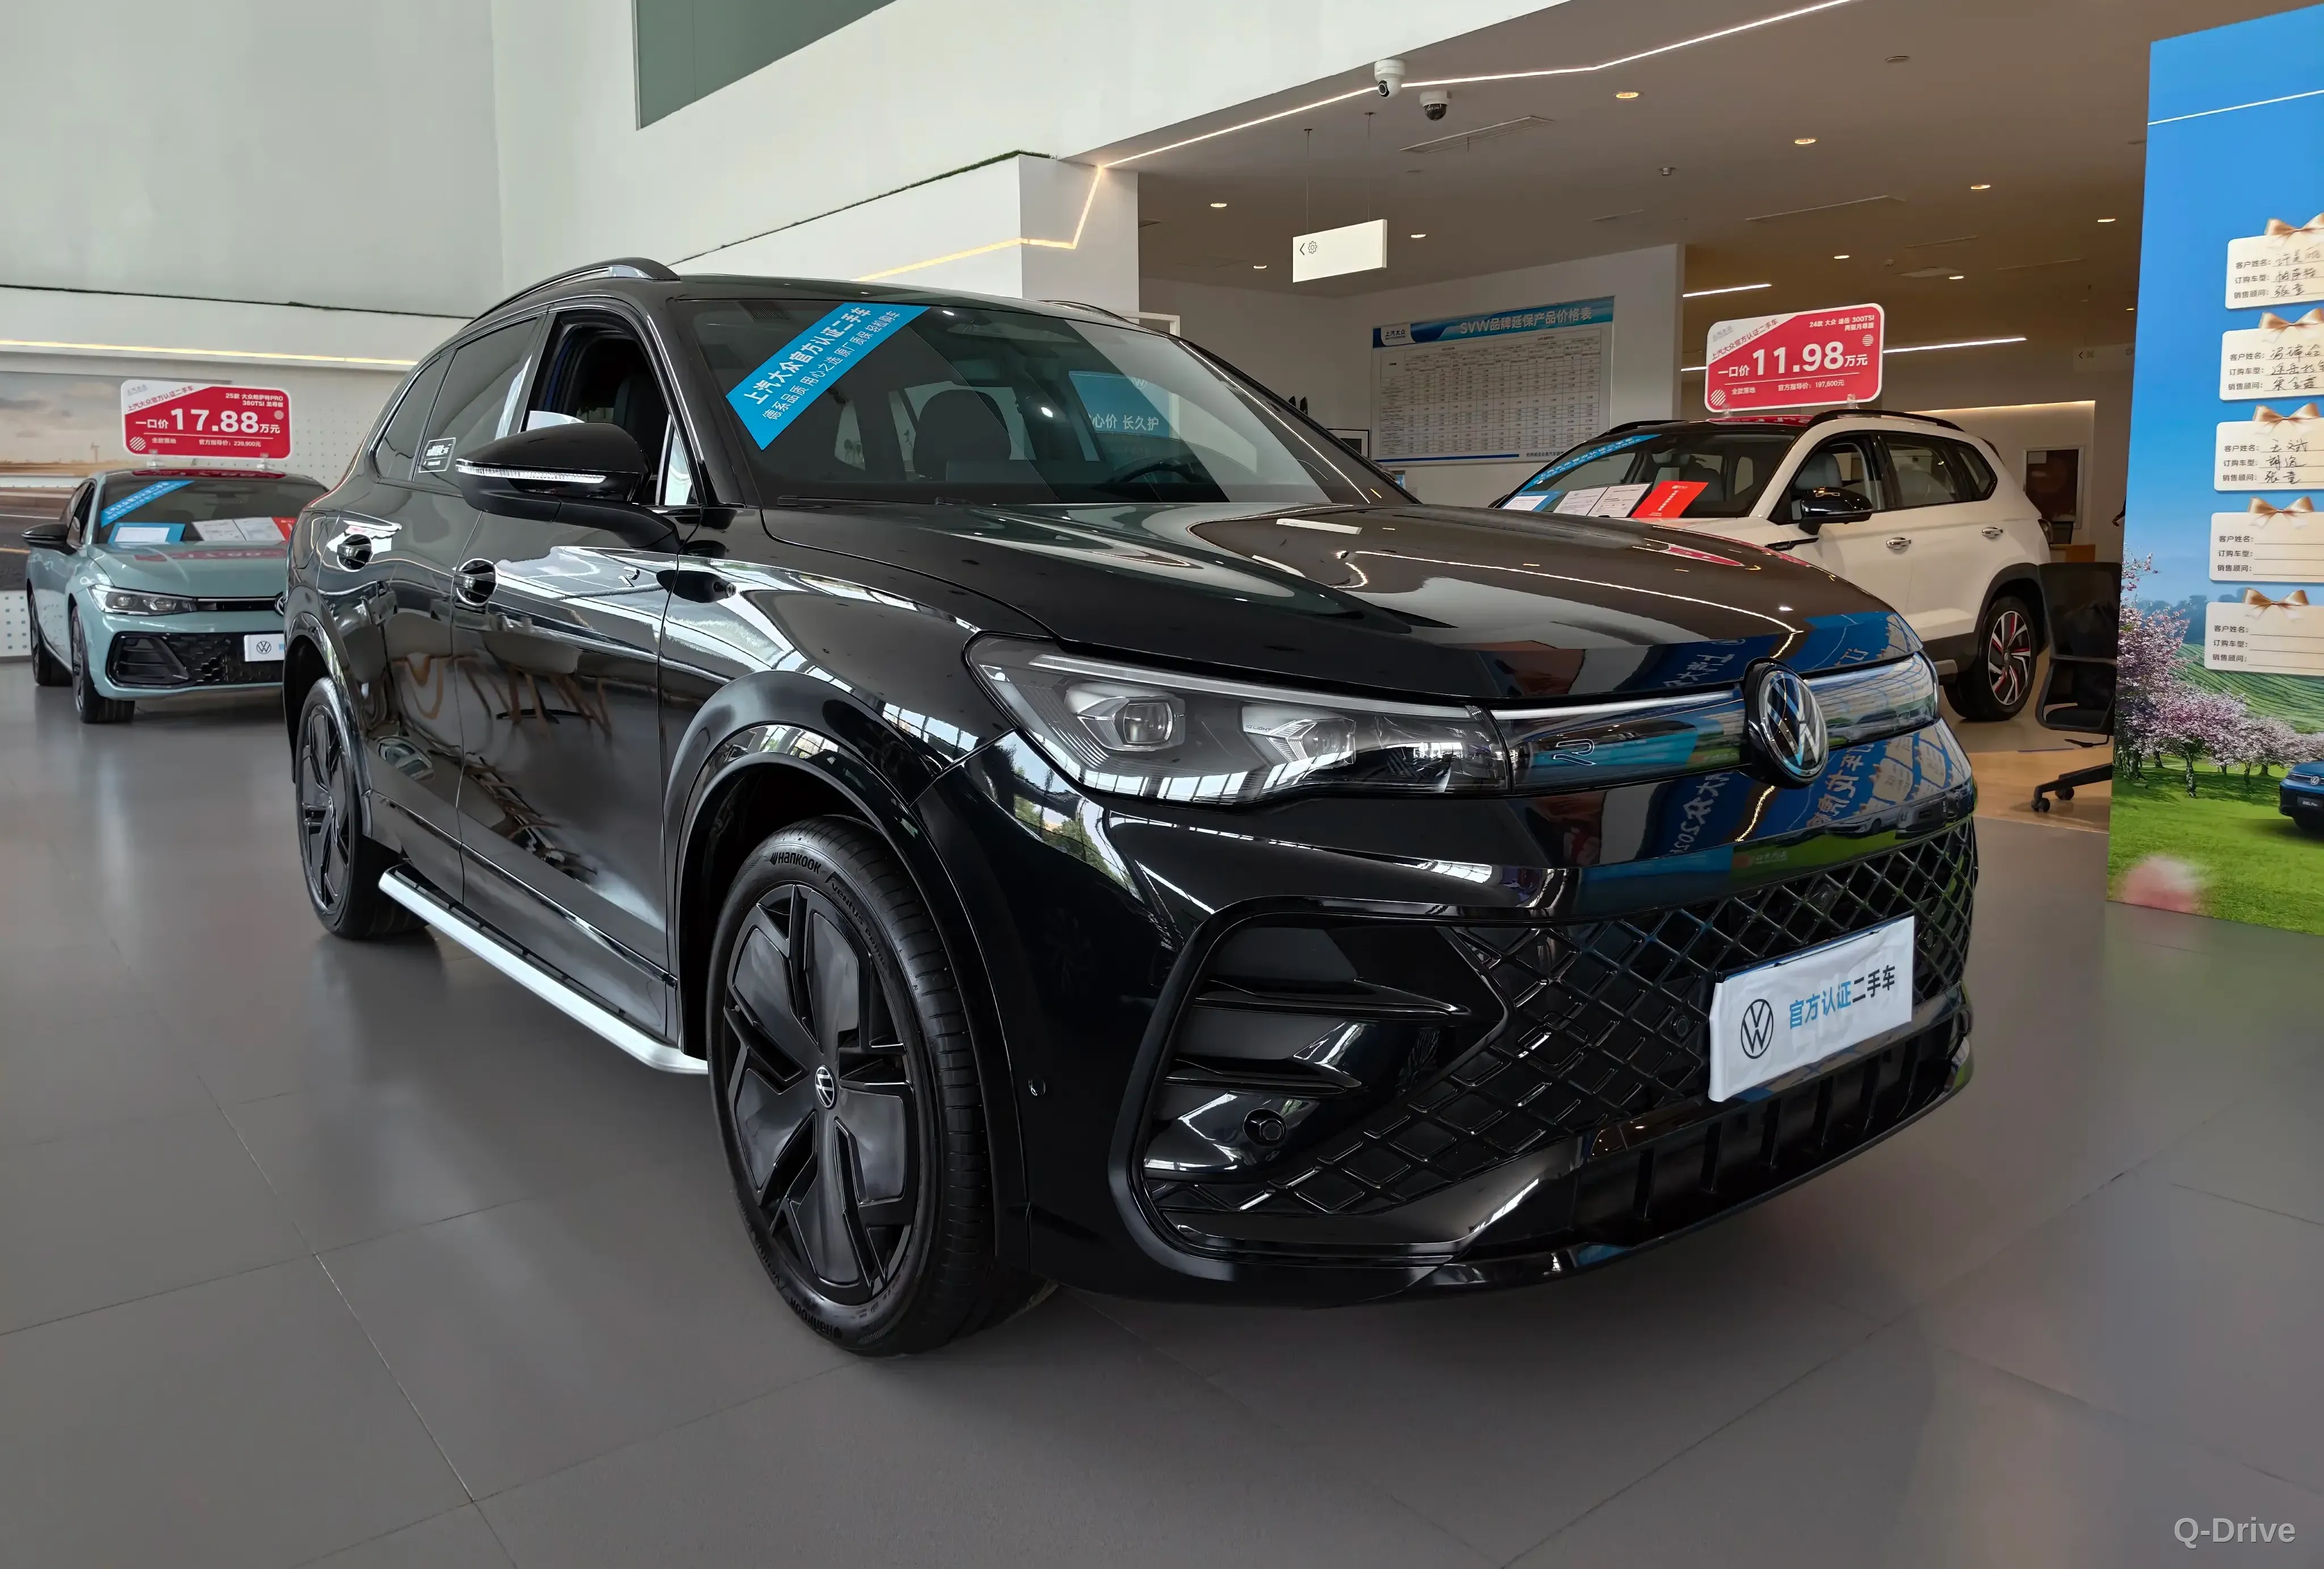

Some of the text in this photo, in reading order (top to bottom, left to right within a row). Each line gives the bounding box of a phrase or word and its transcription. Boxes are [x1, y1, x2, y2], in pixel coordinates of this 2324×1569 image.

[2235, 259, 2271, 269] 客户姓名：
[2234, 274, 2270, 284] 订购车型：
[2234, 289, 2269, 299] 销售顾问：
[1712, 318, 1778, 360] 上汽大众官方认证二手车
[743, 307, 871, 405] 上汽大众官方认证二手车
[1717, 340, 1868, 377] 一口价 11.98 万元
[2230, 352, 2265, 361] 客户姓名：
[762, 310, 901, 420] 德系品质 用心之选 原厂质保 轻松购车
[2229, 367, 2264, 376] 订购车型：
[2228, 382, 2263, 390] 销售顾问：
[135, 408, 281, 434] 一口价 17.88 万元
[1123, 414, 1159, 431] 长久护
[2222, 473, 2257, 482] 销售顾问：
[2213, 625, 2249, 633] 客户姓名：
[2213, 640, 2248, 648] 订购车型：
[2212, 654, 2247, 662] 销售顾问：
[1789, 965, 1896, 1030] 官方认证二手车
